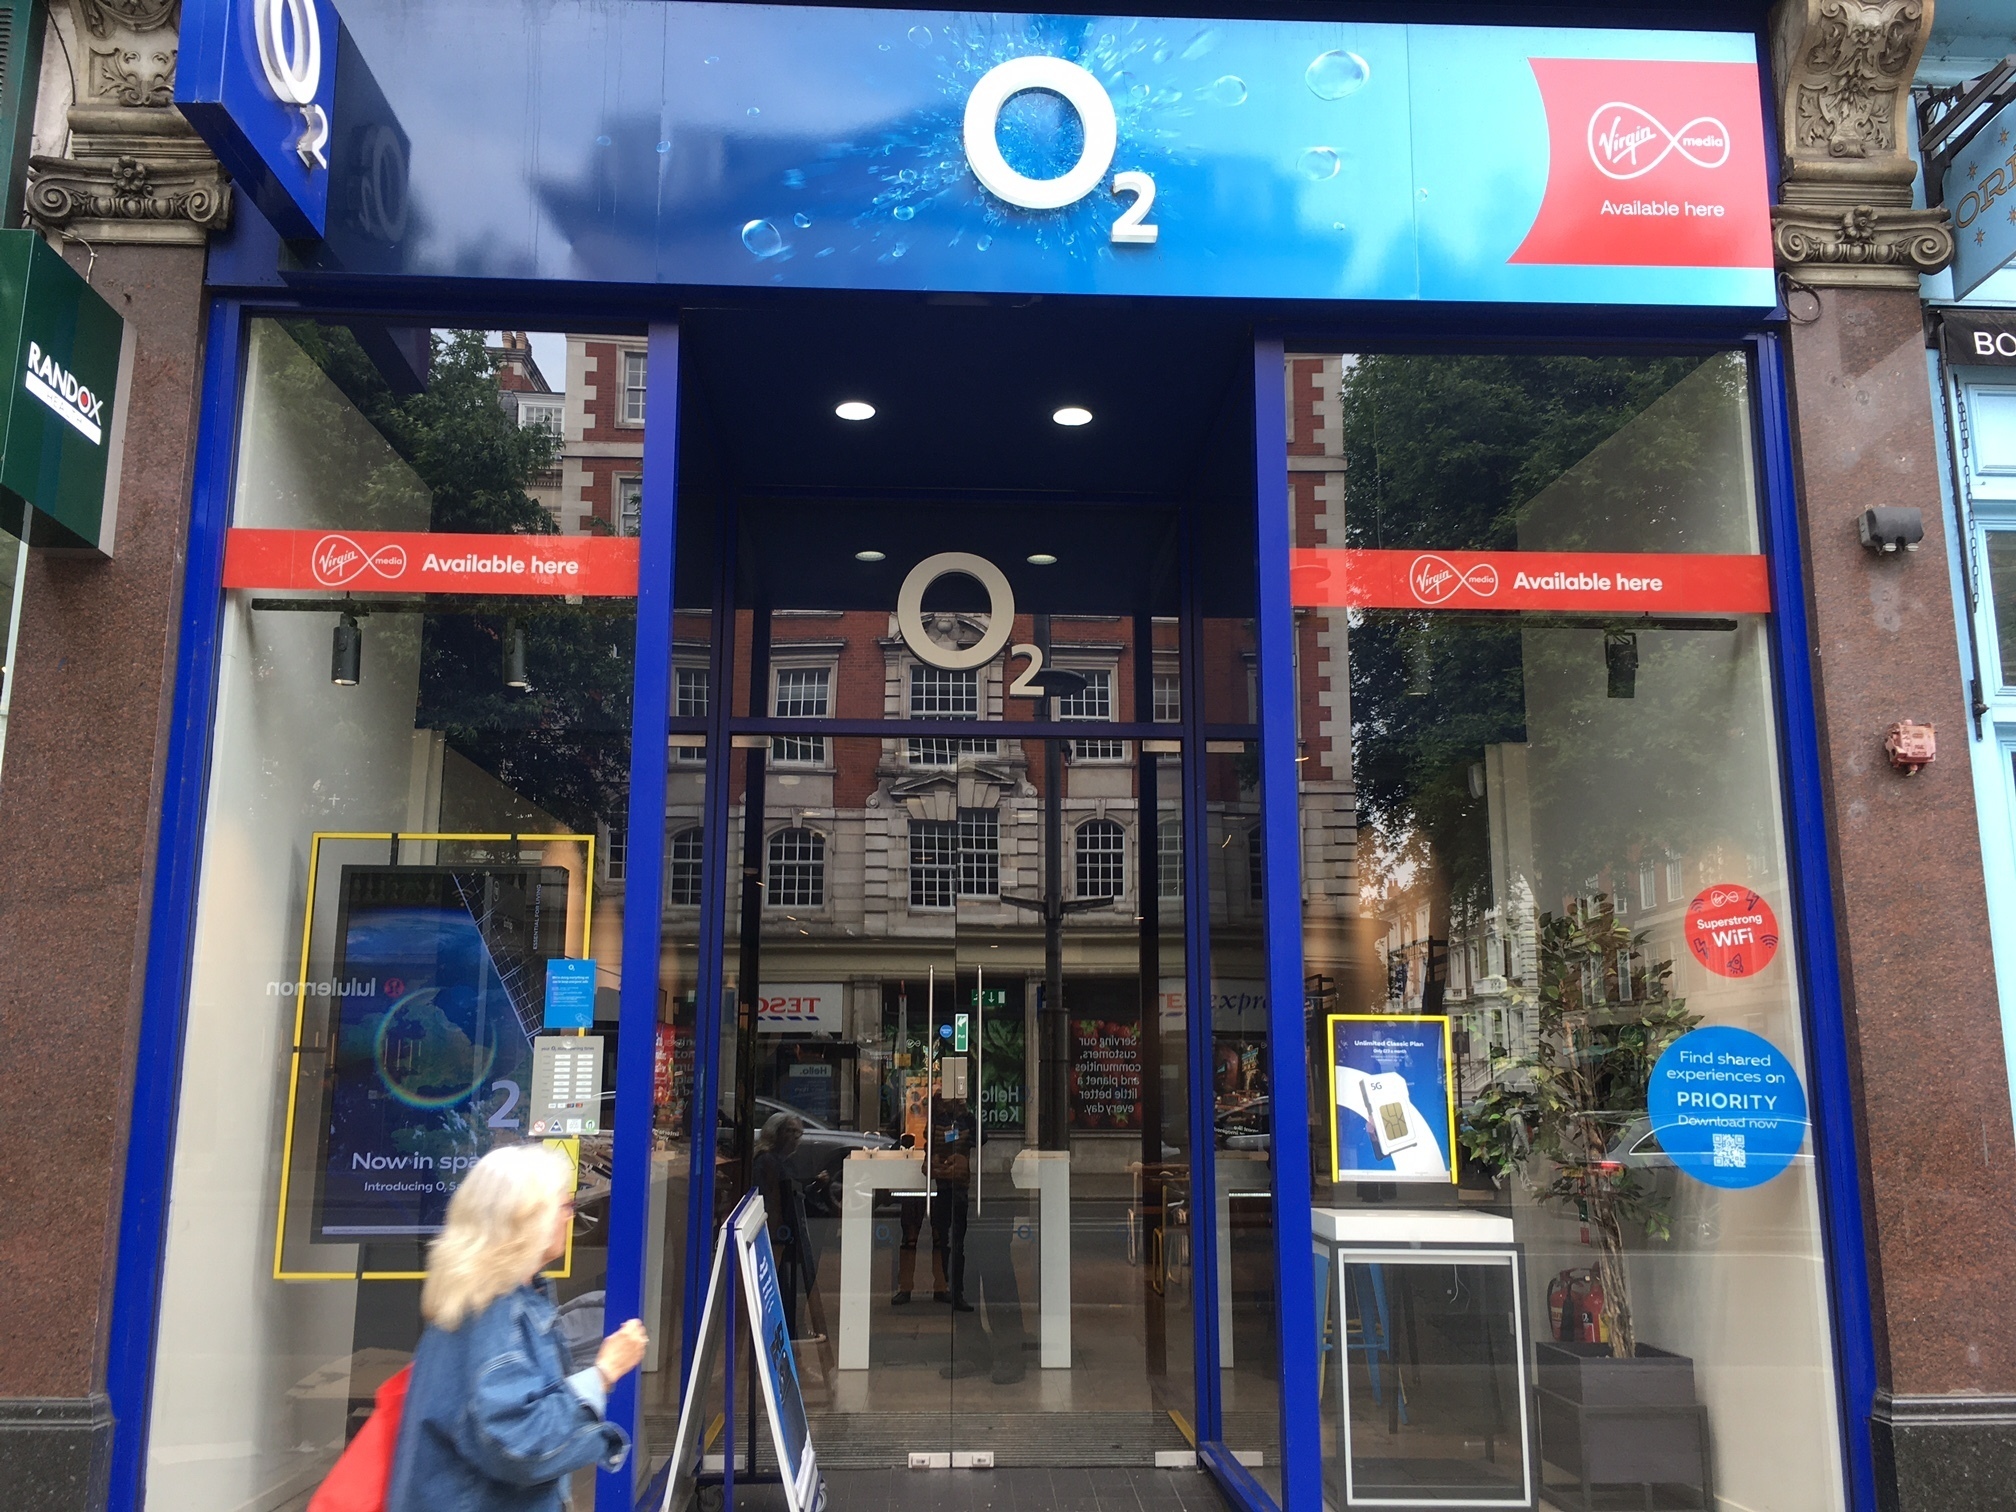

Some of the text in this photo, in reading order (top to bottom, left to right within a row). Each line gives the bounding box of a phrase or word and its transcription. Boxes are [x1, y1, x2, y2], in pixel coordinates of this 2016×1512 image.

[963, 55, 1158, 243] O2
[1599, 116, 1723, 165] Virgin media
[1601, 200, 1725, 217] Available here
[28, 341, 103, 427] RANDOX
[319, 544, 579, 577] Virgin media Available here
[1416, 564, 1663, 595] Virgin media Available here
[897, 552, 1044, 697] O2
[1697, 914, 1763, 930] Superstrong
[1711, 927, 1754, 948] WiFi
[1680, 1051, 1771, 1067] Find shared
[1666, 1069, 1786, 1083] experiences on
[1371, 1082, 1382, 1090] 5G
[1677, 1092, 1777, 1110] PRIORITY
[1678, 1115, 1778, 1129] Download now
[352, 1151, 479, 1174] Now in spa
[364, 1181, 433, 1193] Introducing
